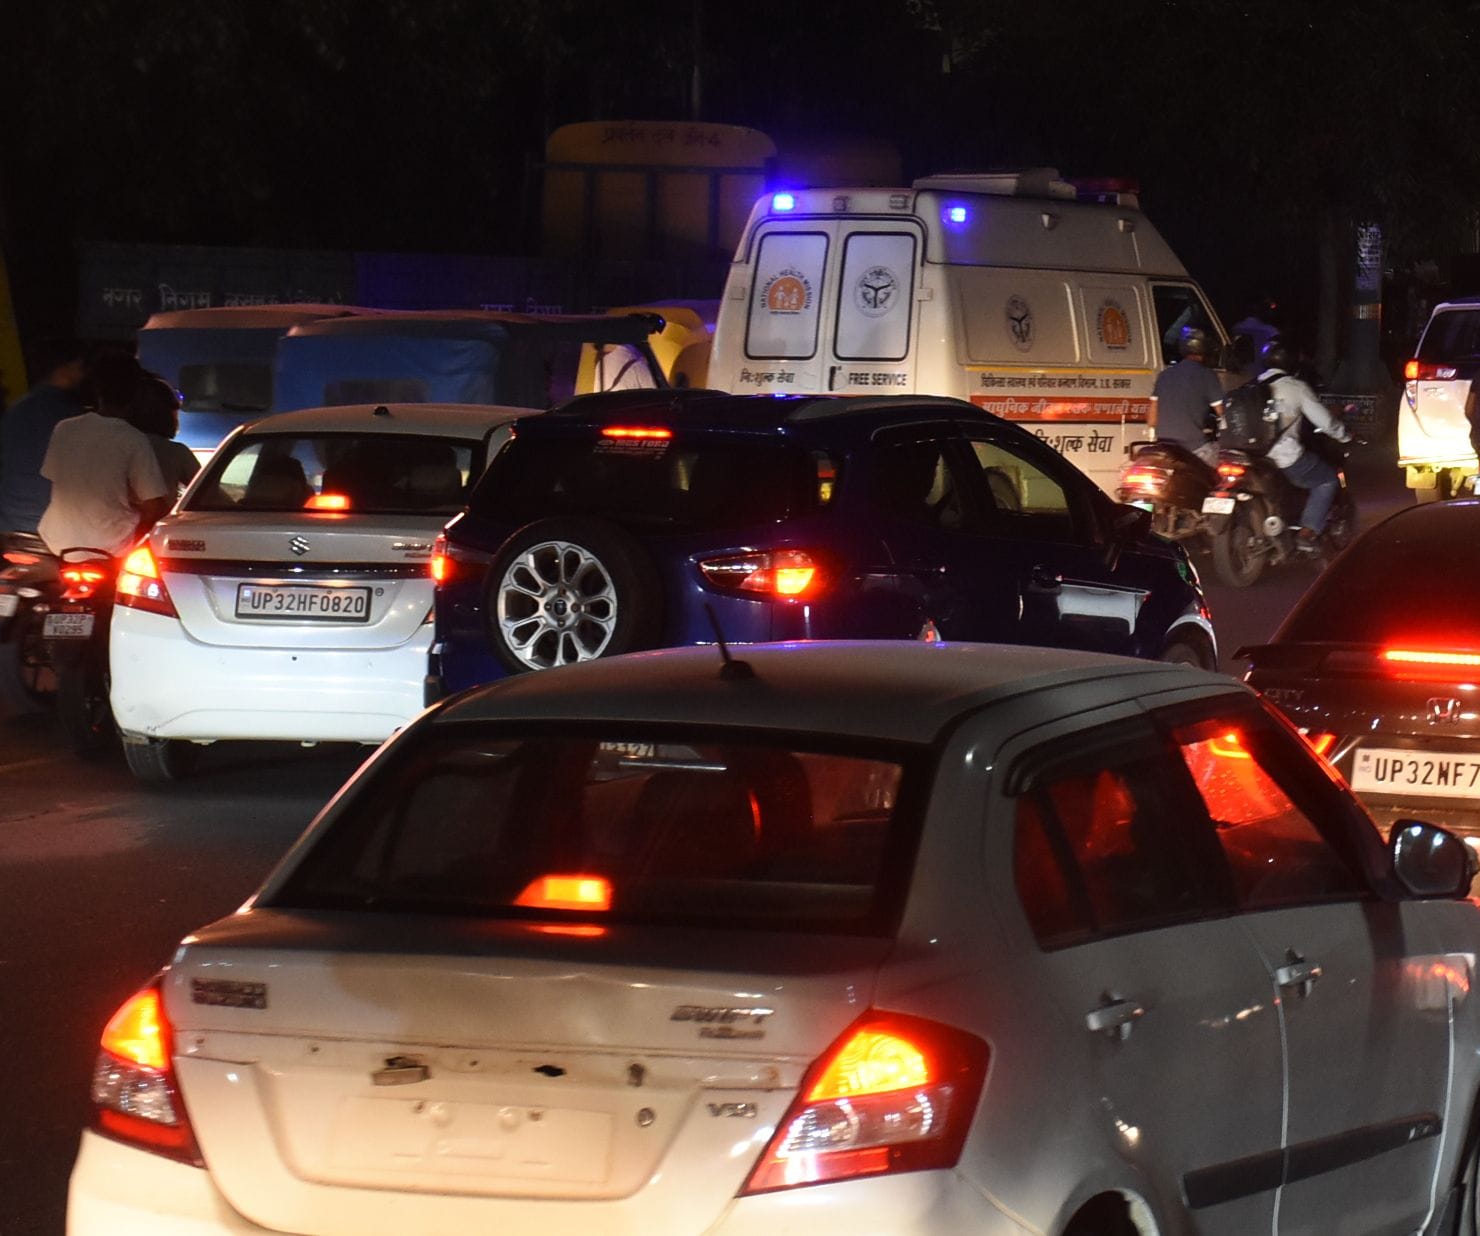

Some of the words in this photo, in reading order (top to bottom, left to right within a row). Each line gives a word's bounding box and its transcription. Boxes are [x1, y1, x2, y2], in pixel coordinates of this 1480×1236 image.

[849, 372, 870, 386] FREE
[872, 373, 907, 386] SERVICE
[1087, 430, 1114, 454] सेवा
[251, 591, 364, 614] UP32HF0820
